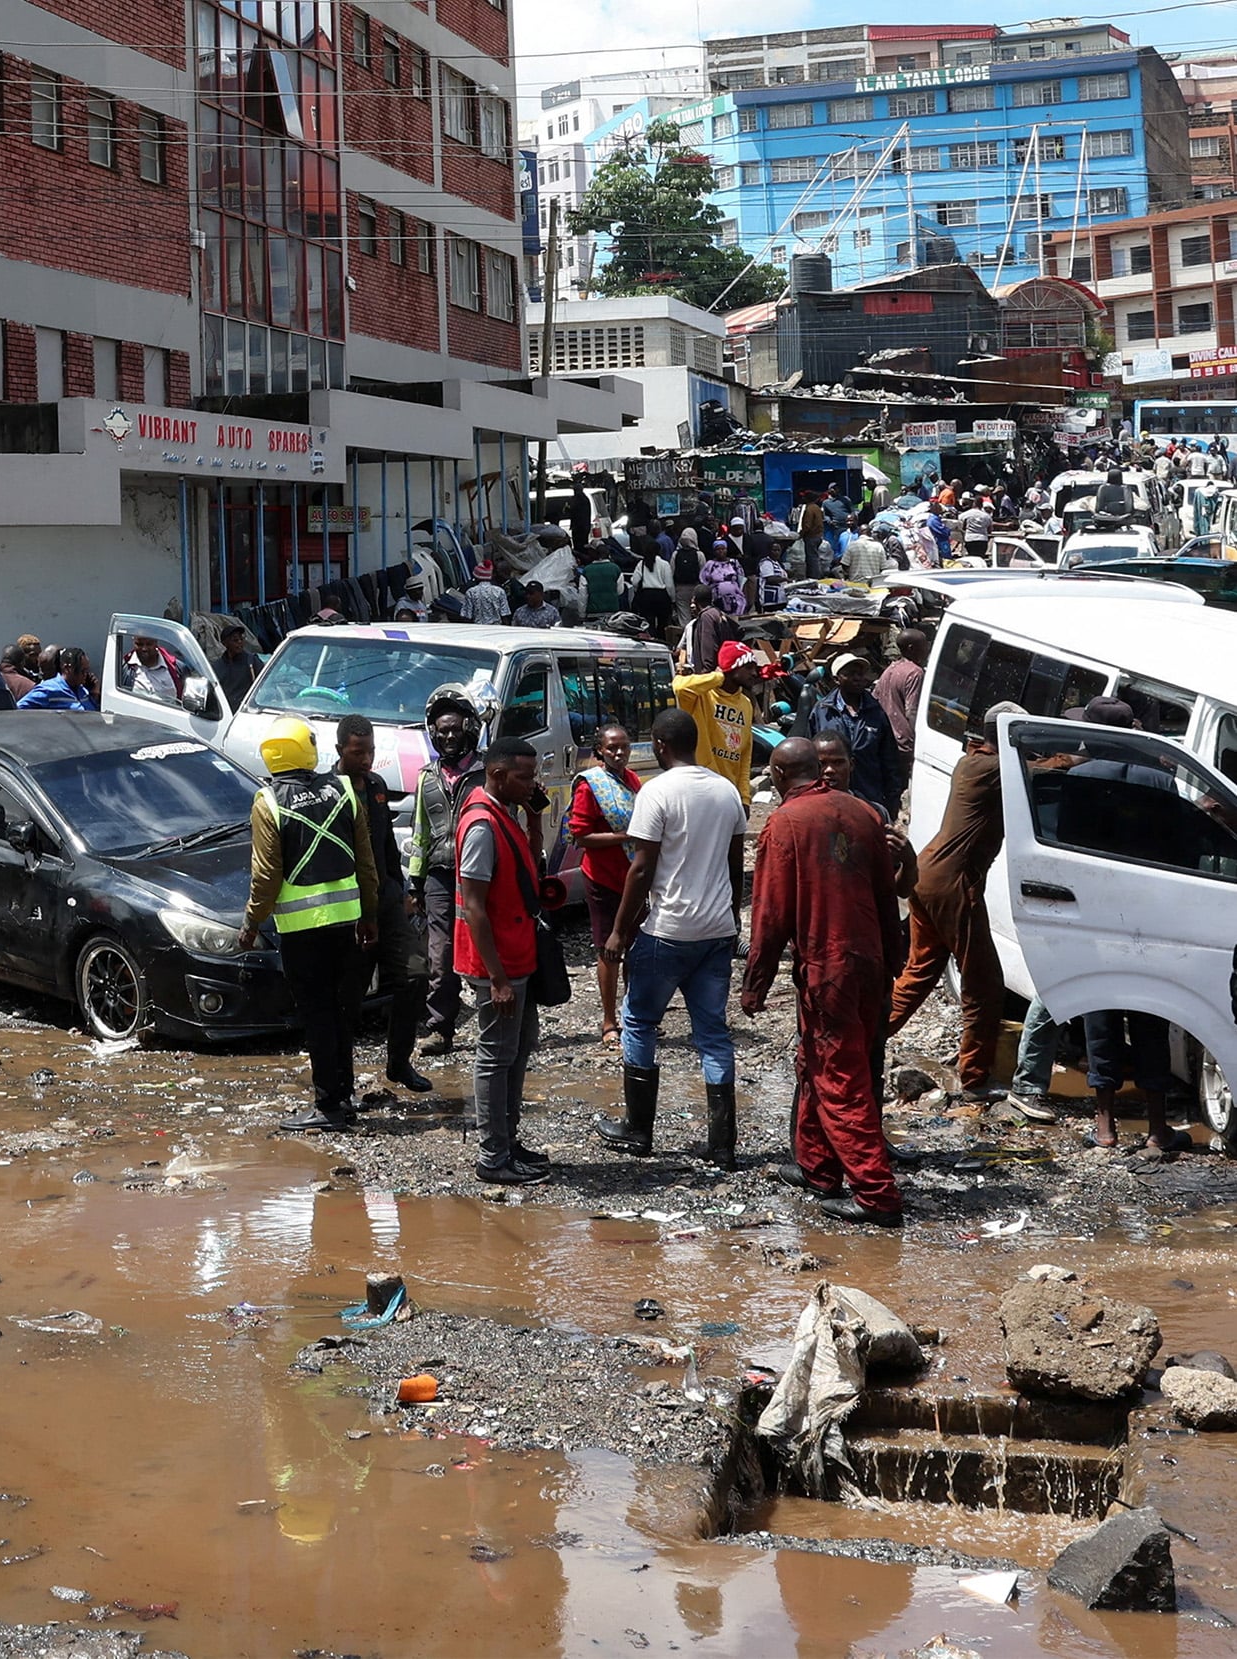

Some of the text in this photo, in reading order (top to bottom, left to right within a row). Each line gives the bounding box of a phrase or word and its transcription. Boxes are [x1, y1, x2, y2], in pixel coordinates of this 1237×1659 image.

[855, 65, 991, 93] ALAM-TARA LODGE
[1189, 350, 1218, 363] DIVINE
[137, 414, 309, 453] VIBRANT AUTO SPARES
[977, 423, 986, 431] WE
[986, 422, 999, 430] CUT
[671, 459, 694, 473] KEY
[715, 704, 745, 726] HCA
